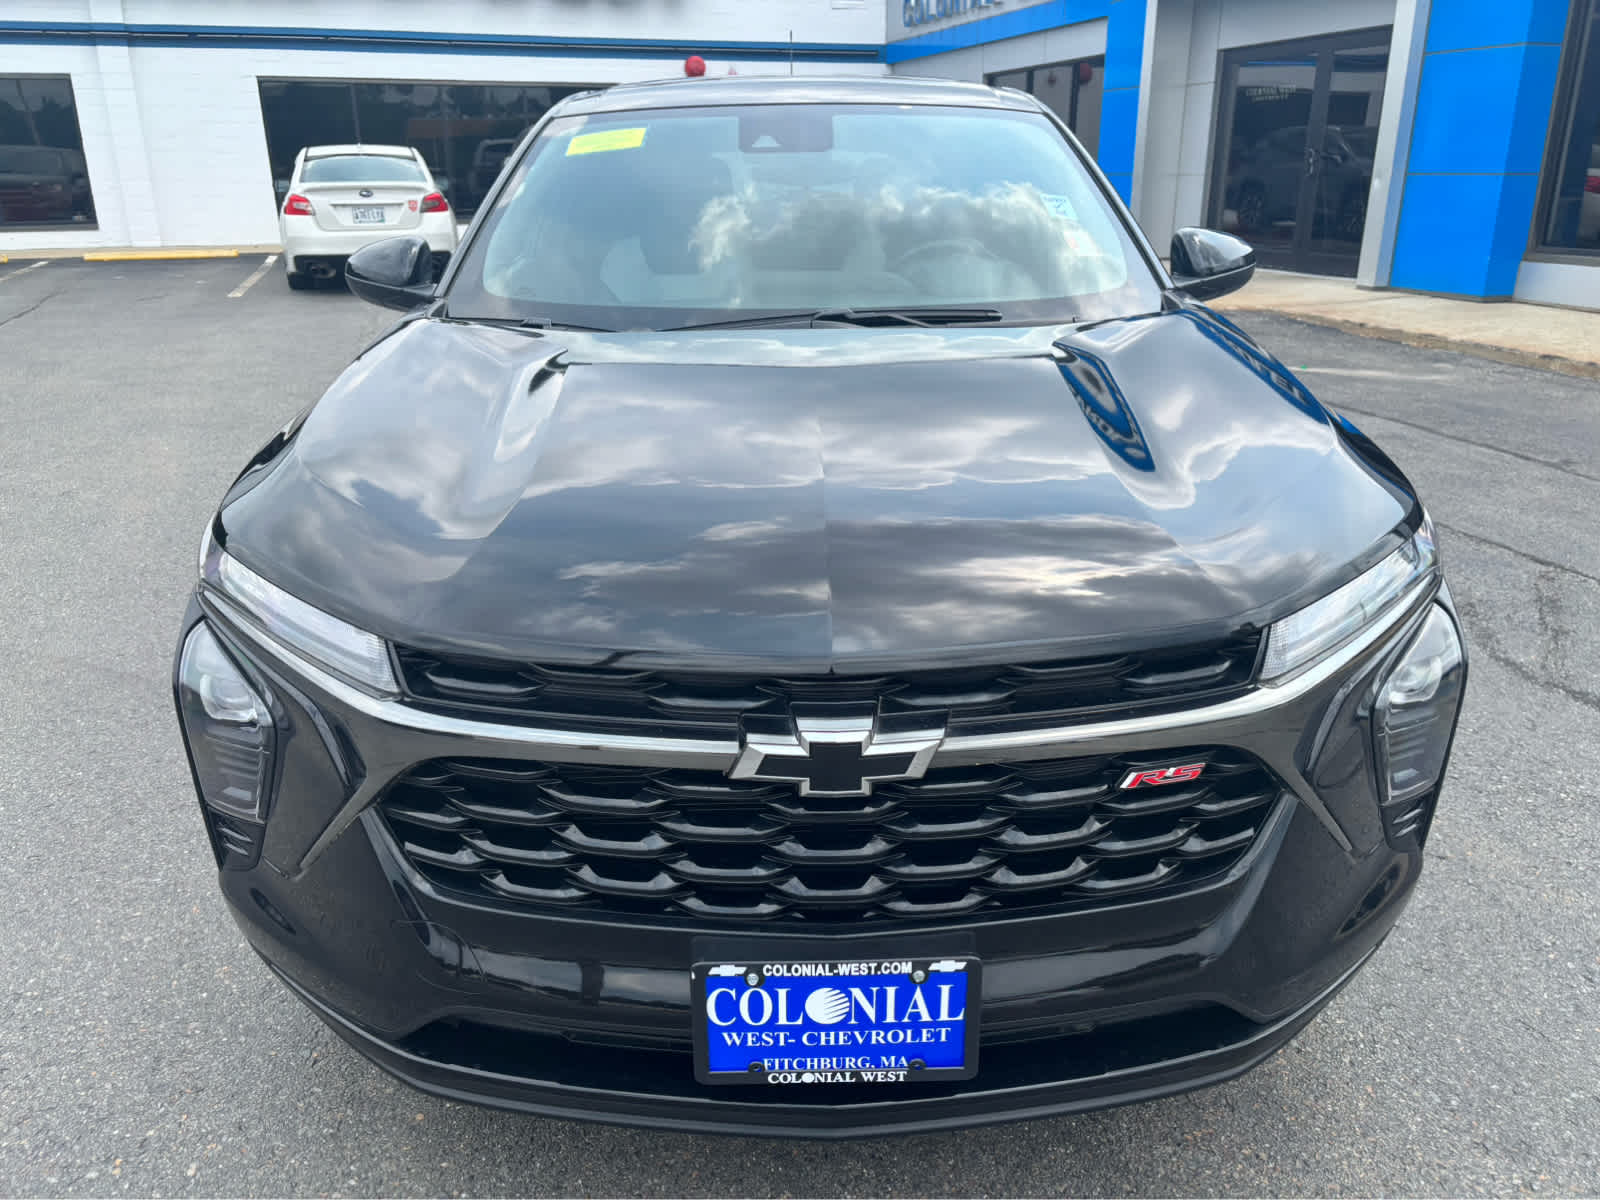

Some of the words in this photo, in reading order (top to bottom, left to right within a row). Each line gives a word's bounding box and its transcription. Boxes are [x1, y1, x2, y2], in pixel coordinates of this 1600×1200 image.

[903, 0, 996, 27] COLO
[1119, 762, 1206, 789] RS
[762, 961, 913, 977] COLONIAL-WEST.COM
[706, 984, 966, 1026] COLONIAL
[801, 1027, 952, 1047] CHEVROLET
[880, 1055, 909, 1068] MA
[767, 1071, 856, 1084] COLONIAL
[860, 1071, 908, 1083] WEST
